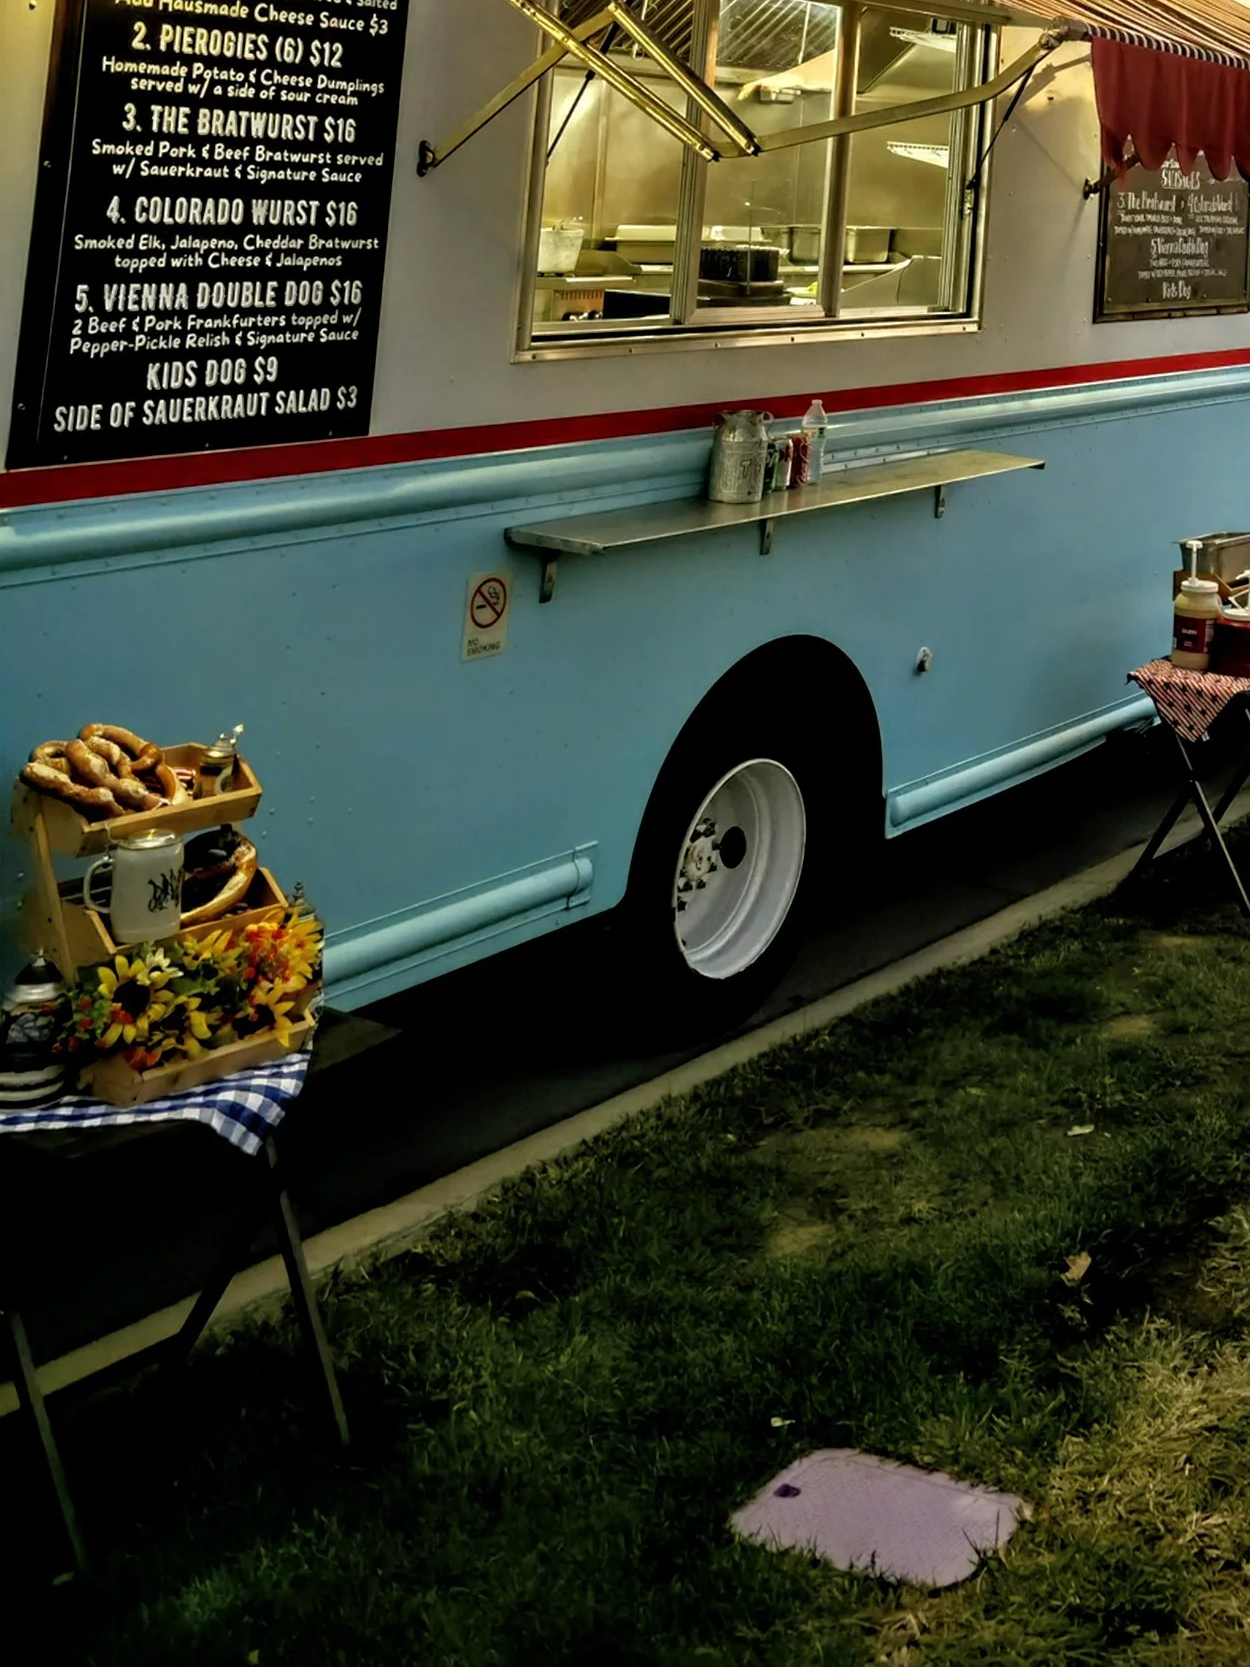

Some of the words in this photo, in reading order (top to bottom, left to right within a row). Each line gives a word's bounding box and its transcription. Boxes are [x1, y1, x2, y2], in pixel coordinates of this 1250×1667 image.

[254, 3, 315, 26] Cheese
[319, 11, 365, 31] Sauce
[369, 13, 389, 37] $3
[131, 21, 151, 51] 2.
[159, 24, 269, 61] PIEROGIES
[275, 36, 304, 64] (6)
[309, 39, 343, 68] $12
[102, 56, 188, 77] Homemade
[192, 63, 245, 82] Potato
[260, 69, 313, 87] Cheese
[317, 74, 385, 97] Dumplings
[130, 77, 184, 93] served
[188, 77, 210, 99] w/
[213, 85, 222, 95] a
[227, 82, 256, 98] side
[259, 86, 276, 100] of
[280, 89, 311, 102] sour
[315, 92, 359, 106] cream
[122, 103, 142, 132] 3.
[150, 104, 191, 134] THE
[197, 108, 319, 141] BRATWURST
[323, 116, 357, 143] $16
[92, 138, 154, 156] Smoked
[158, 141, 196, 158] Pork
[214, 143, 250, 161] Beef
[255, 145, 332, 164] Bratwurst
[336, 152, 384, 166] served
[112, 157, 136, 179] w/
[140, 160, 229, 178] Sauerkraut
[247, 164, 317, 184] Signature
[321, 168, 362, 183] Sauce
[106, 195, 127, 224] 4.
[134, 196, 244, 225] COLORADO
[252, 199, 320, 226] WURST
[325, 200, 358, 227] $16
[74, 234, 135, 250] Smoked
[138, 234, 166, 251] Elk,
[170, 235, 238, 254] Jalapeno,
[243, 234, 304, 250] Cheddar
[308, 234, 379, 250] Bratwurst
[114, 252, 167, 273] topped
[171, 252, 203, 267] with
[207, 252, 261, 268] Cheese
[276, 252, 342, 271] Jalapenos
[74, 284, 94, 313] 5.
[104, 282, 189, 312] VIENNA
[196, 281, 278, 309] DOUBLE
[284, 280, 324, 307] DOG
[330, 279, 363, 307] $16
[72, 319, 82, 335] 2
[88, 316, 127, 334] Beef
[144, 315, 182, 332] Pork
[187, 313, 286, 331] Frankfurters
[291, 309, 338, 330] topped
[342, 307, 362, 327] w/
[70, 334, 181, 358] Pepper-Pickle
[185, 331, 230, 349] Relish
[247, 331, 315, 349] Signature
[319, 328, 359, 343] Sauce
[147, 360, 198, 390] KIDS
[205, 358, 247, 387] DOG
[253, 356, 278, 385] $9
[53, 404, 103, 432] SIDE
[110, 401, 136, 428] OF
[142, 392, 270, 425] SAUERKRAUT
[275, 388, 331, 414] SALAD
[336, 385, 358, 410] $3
